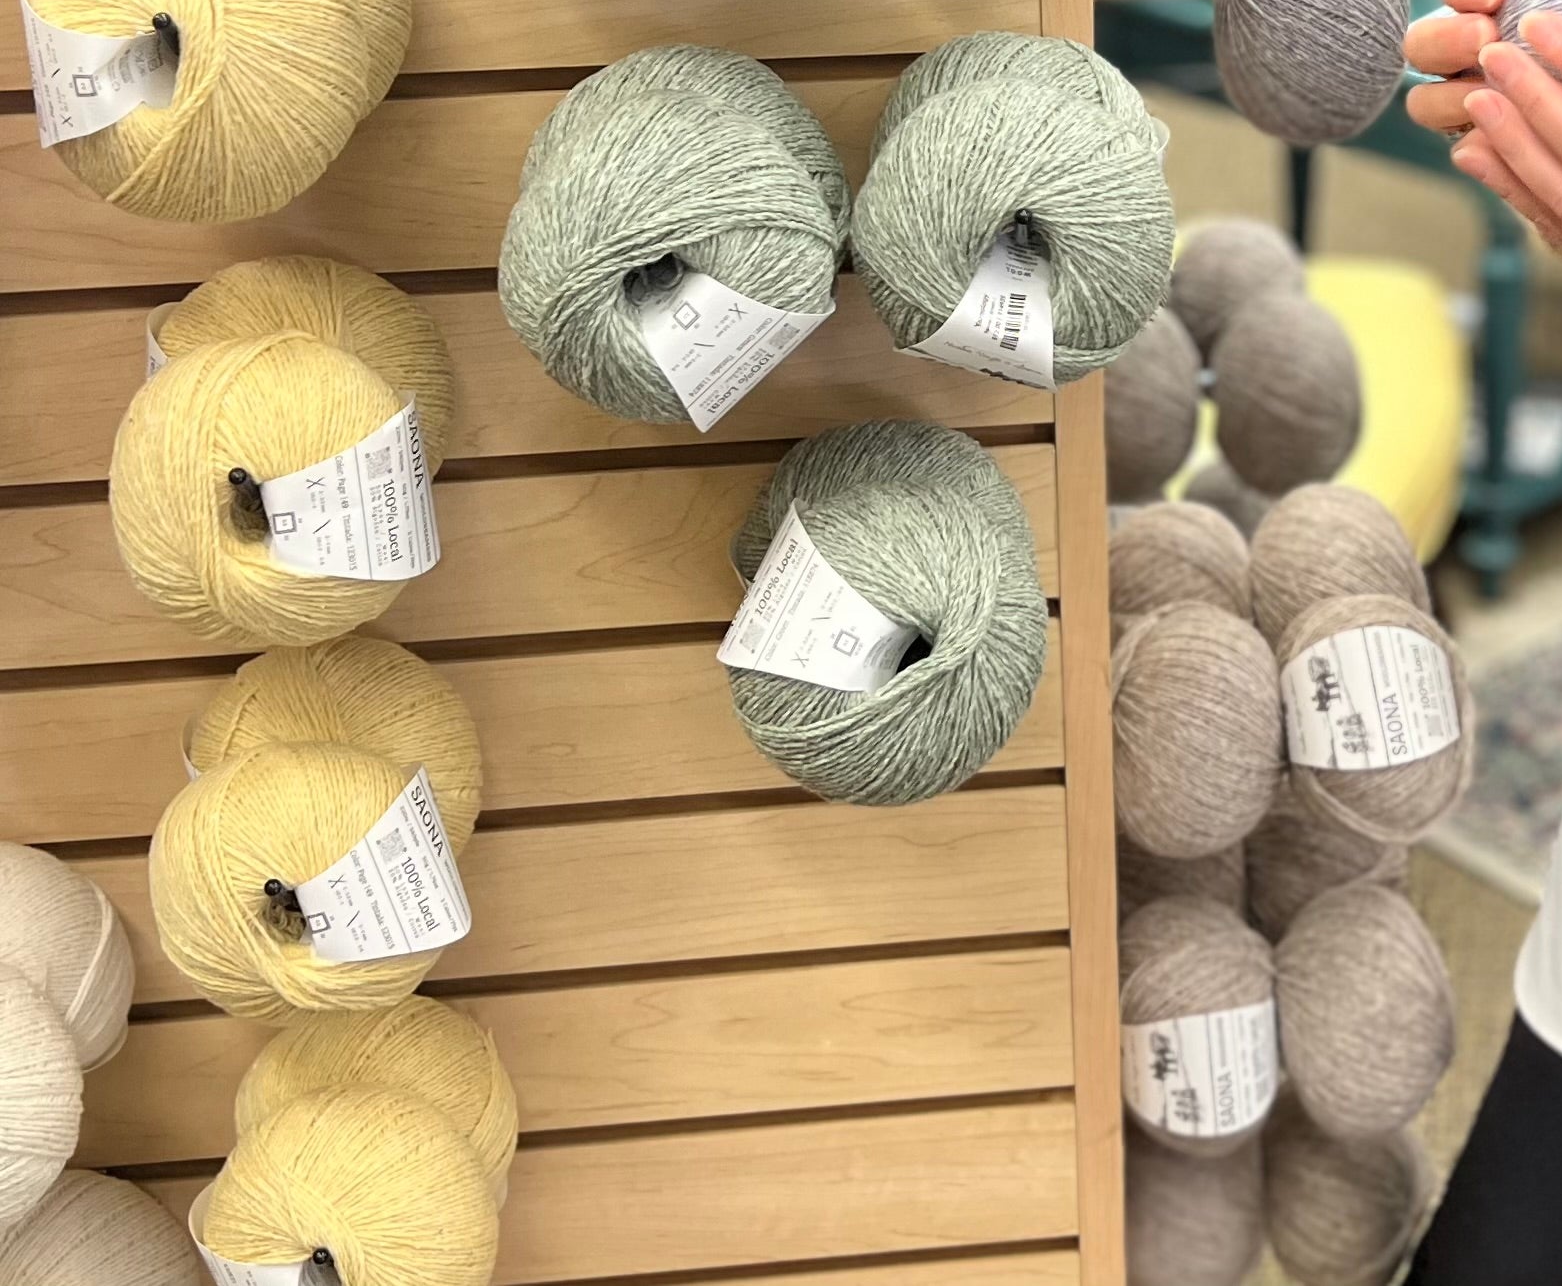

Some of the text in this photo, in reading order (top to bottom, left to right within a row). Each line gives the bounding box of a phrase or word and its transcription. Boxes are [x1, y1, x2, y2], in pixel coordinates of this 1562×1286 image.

[737, 351, 774, 386] 100%
[405, 410, 426, 489] SAONA
[382, 478, 404, 562] 100% Local
[753, 538, 799, 615] 100% Local
[1382, 693, 1408, 756] SAONA
[410, 785, 446, 857] SAONA
[400, 856, 441, 932] 100% Local
[1216, 1070, 1236, 1127] SAONA
